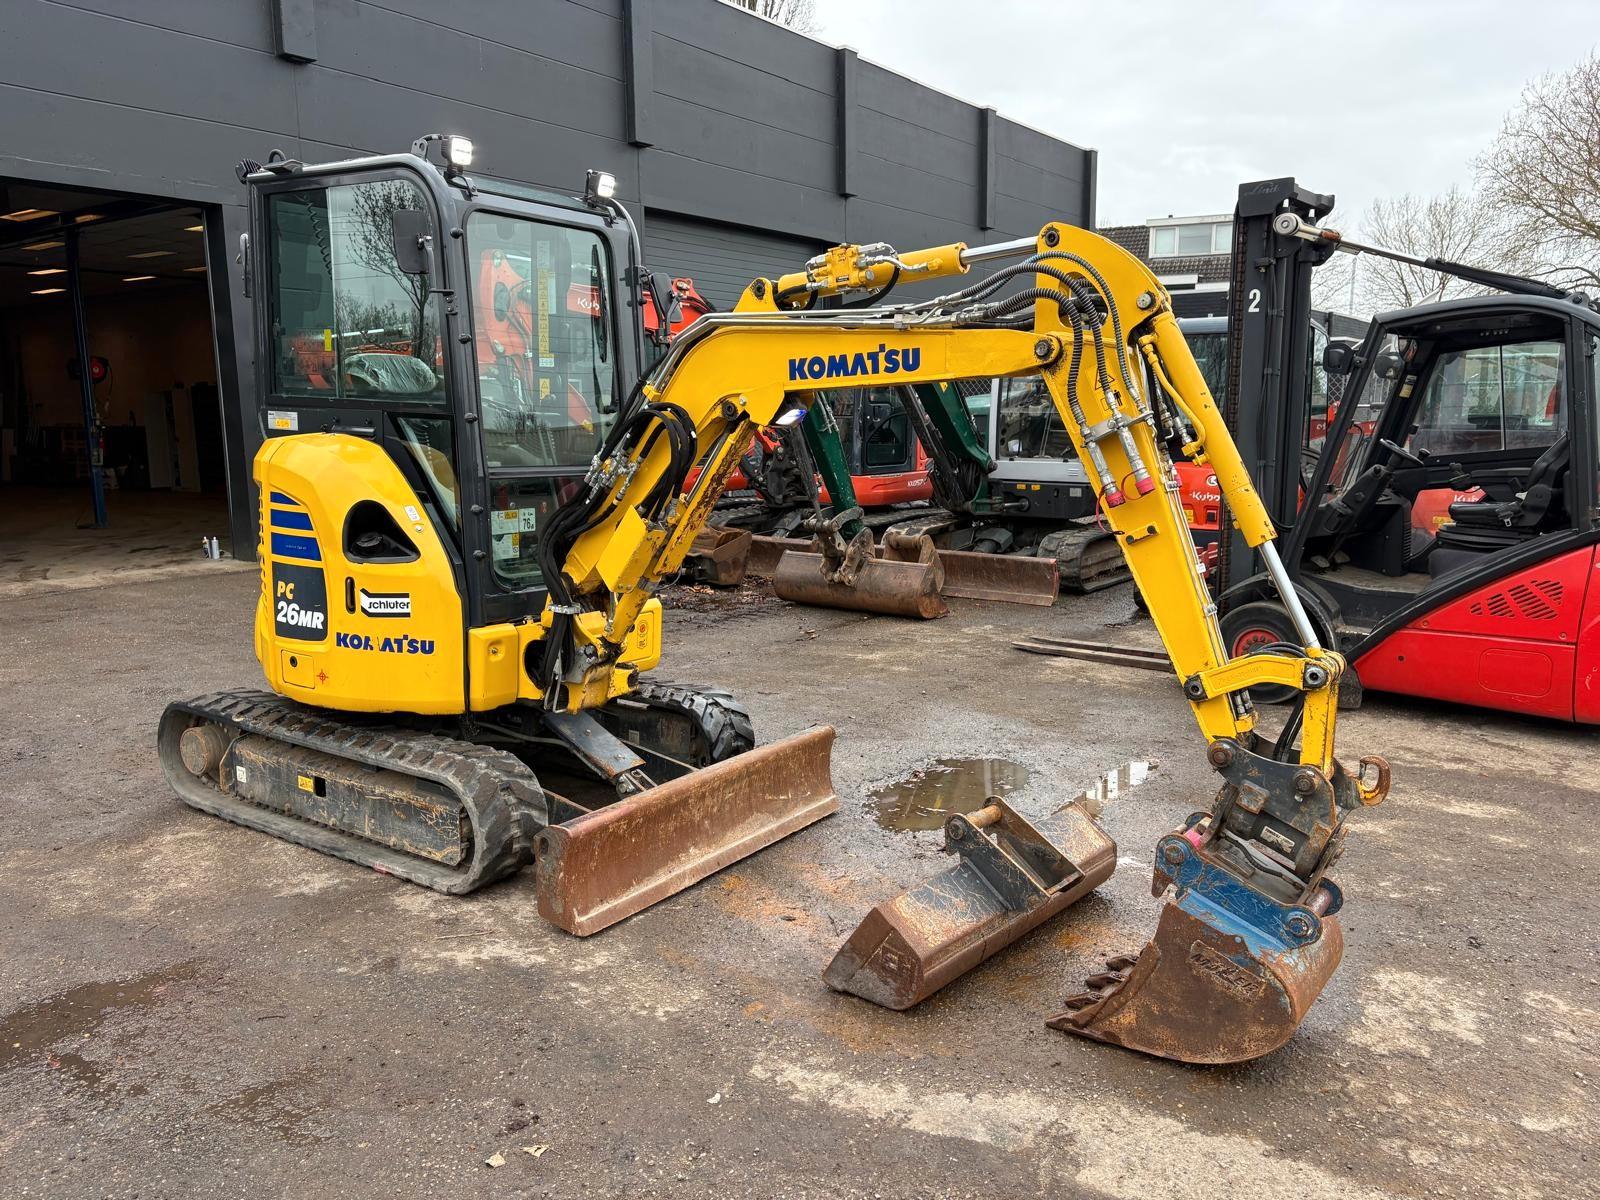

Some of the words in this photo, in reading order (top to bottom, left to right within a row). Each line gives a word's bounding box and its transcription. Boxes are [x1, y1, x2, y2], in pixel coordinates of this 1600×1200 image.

[576, 297, 601, 311] Kub
[1248, 288, 1261, 313] 2
[788, 343, 921, 381] KOMATSU
[1189, 490, 1221, 502] Kubo
[277, 580, 295, 599] PC
[277, 601, 325, 630] 26MR
